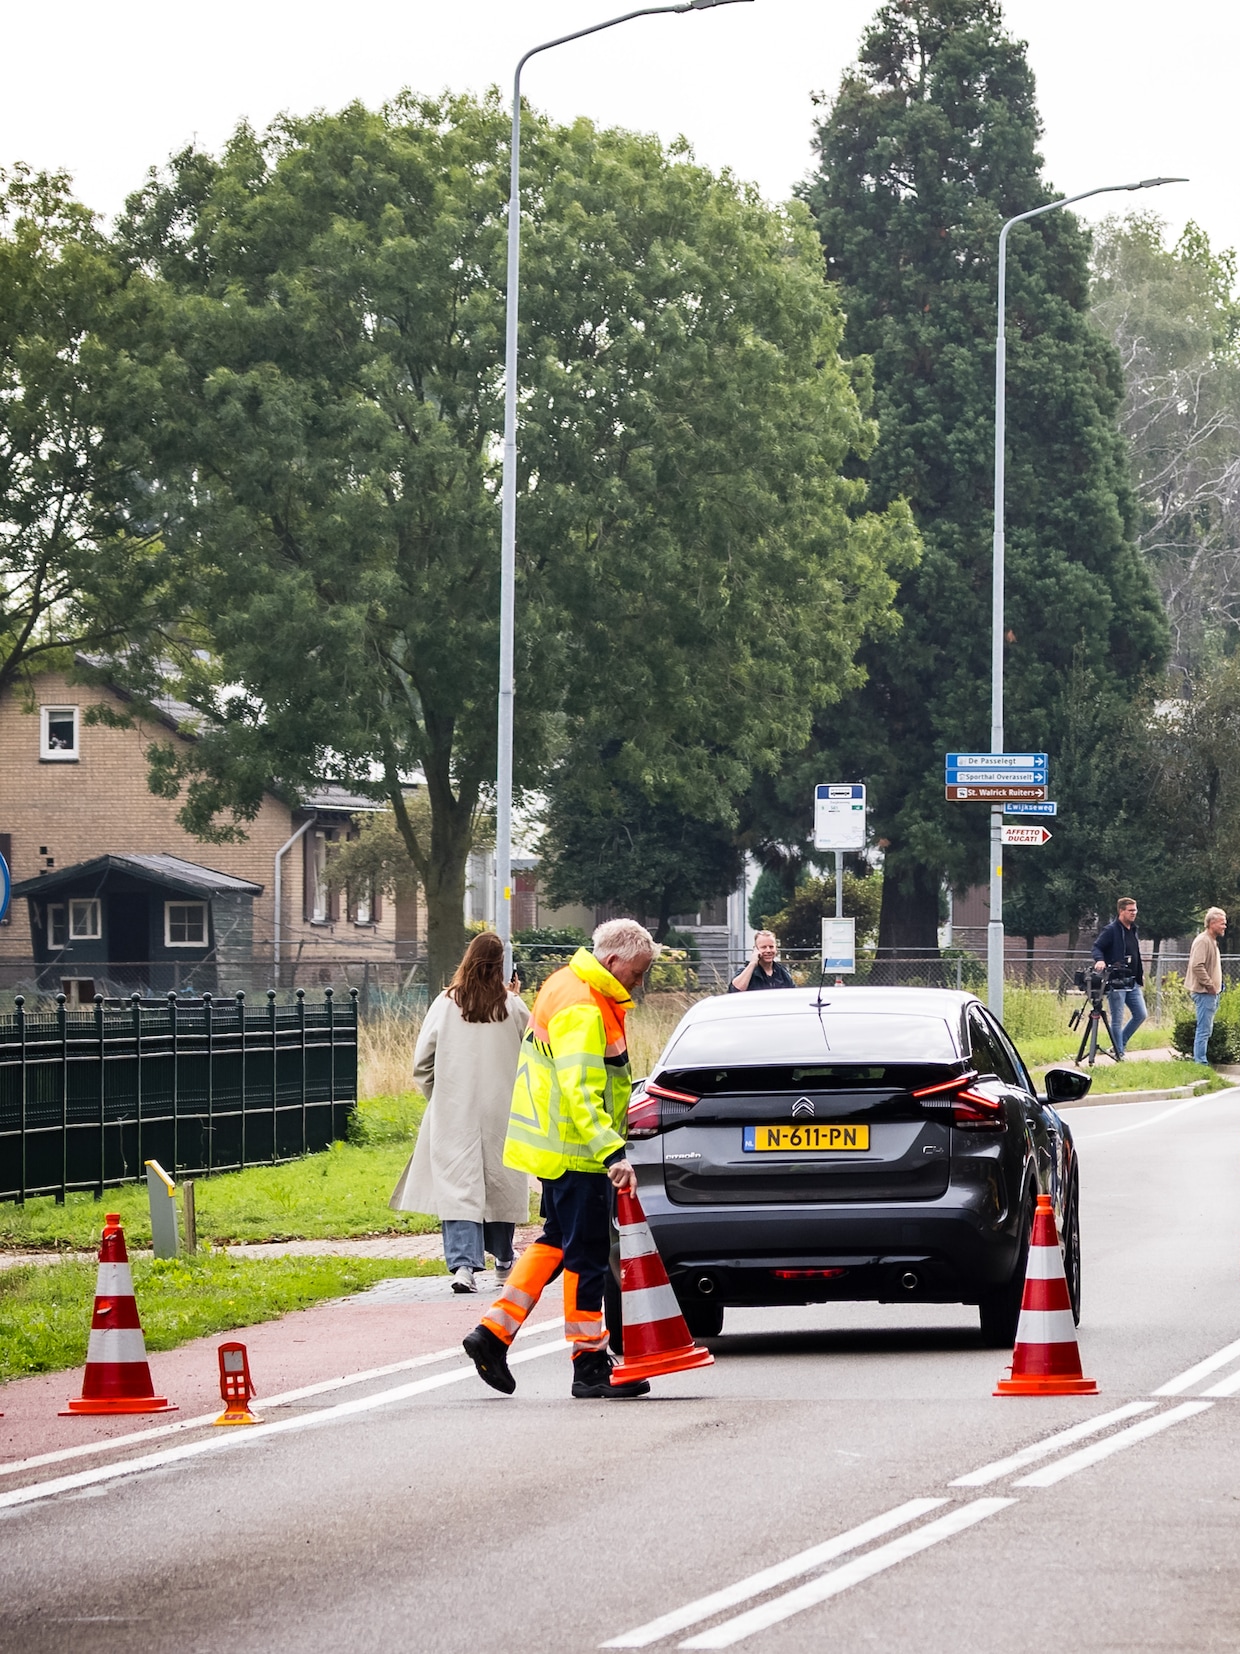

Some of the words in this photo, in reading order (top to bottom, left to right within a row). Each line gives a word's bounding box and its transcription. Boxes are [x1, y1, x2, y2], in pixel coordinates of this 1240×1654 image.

[968, 757, 979, 765] De
[980, 757, 1017, 766] Passelegt
[965, 773, 995, 782] Sporthal
[996, 773, 1033, 781] Overasselt
[1006, 802, 1053, 812] Ewijkseweg
[767, 1127, 857, 1147] N-611-PN
